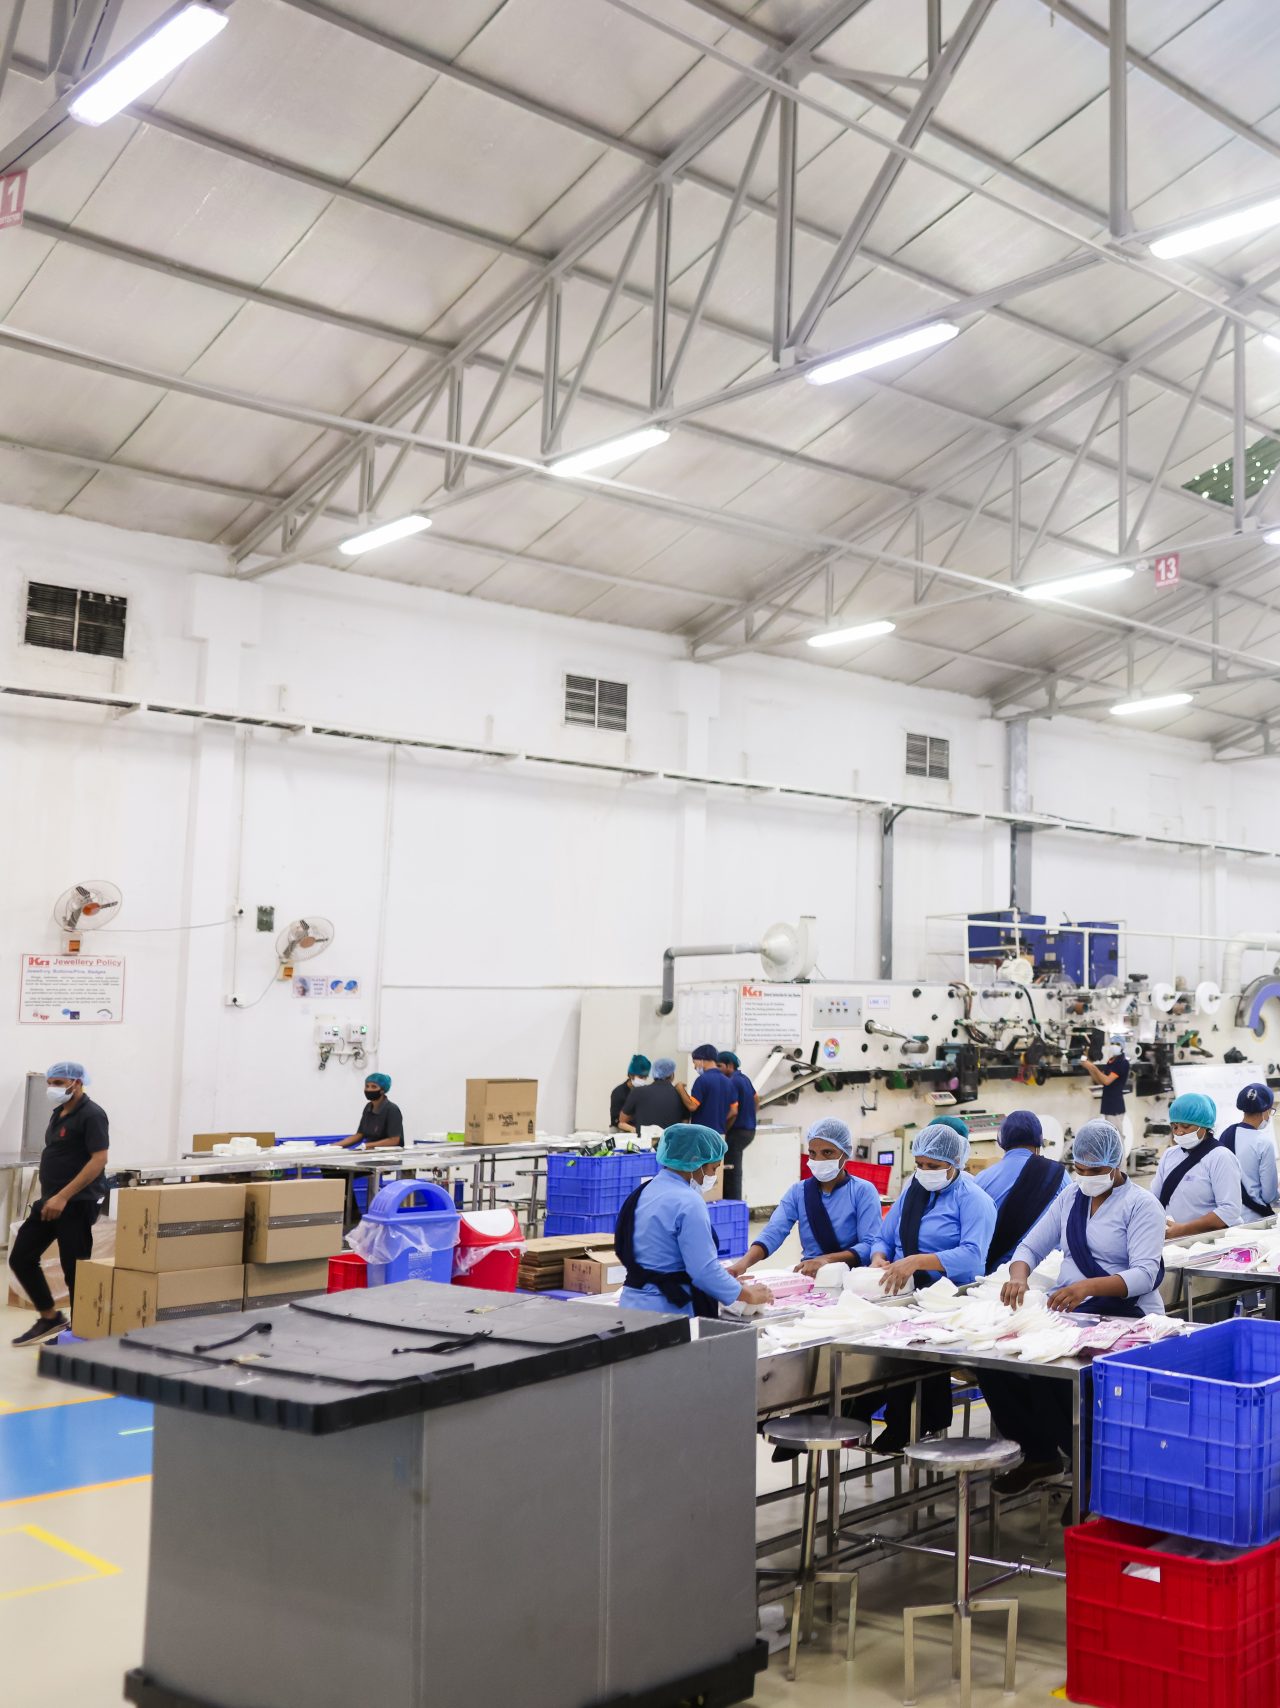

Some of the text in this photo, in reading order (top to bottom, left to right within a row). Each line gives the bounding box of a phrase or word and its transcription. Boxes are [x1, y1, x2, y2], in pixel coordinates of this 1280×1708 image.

[0, 176, 20, 216] 1
[1158, 557, 1177, 580] 13
[53, 958, 93, 967] Jewellery
[96, 958, 121, 967] Policy
